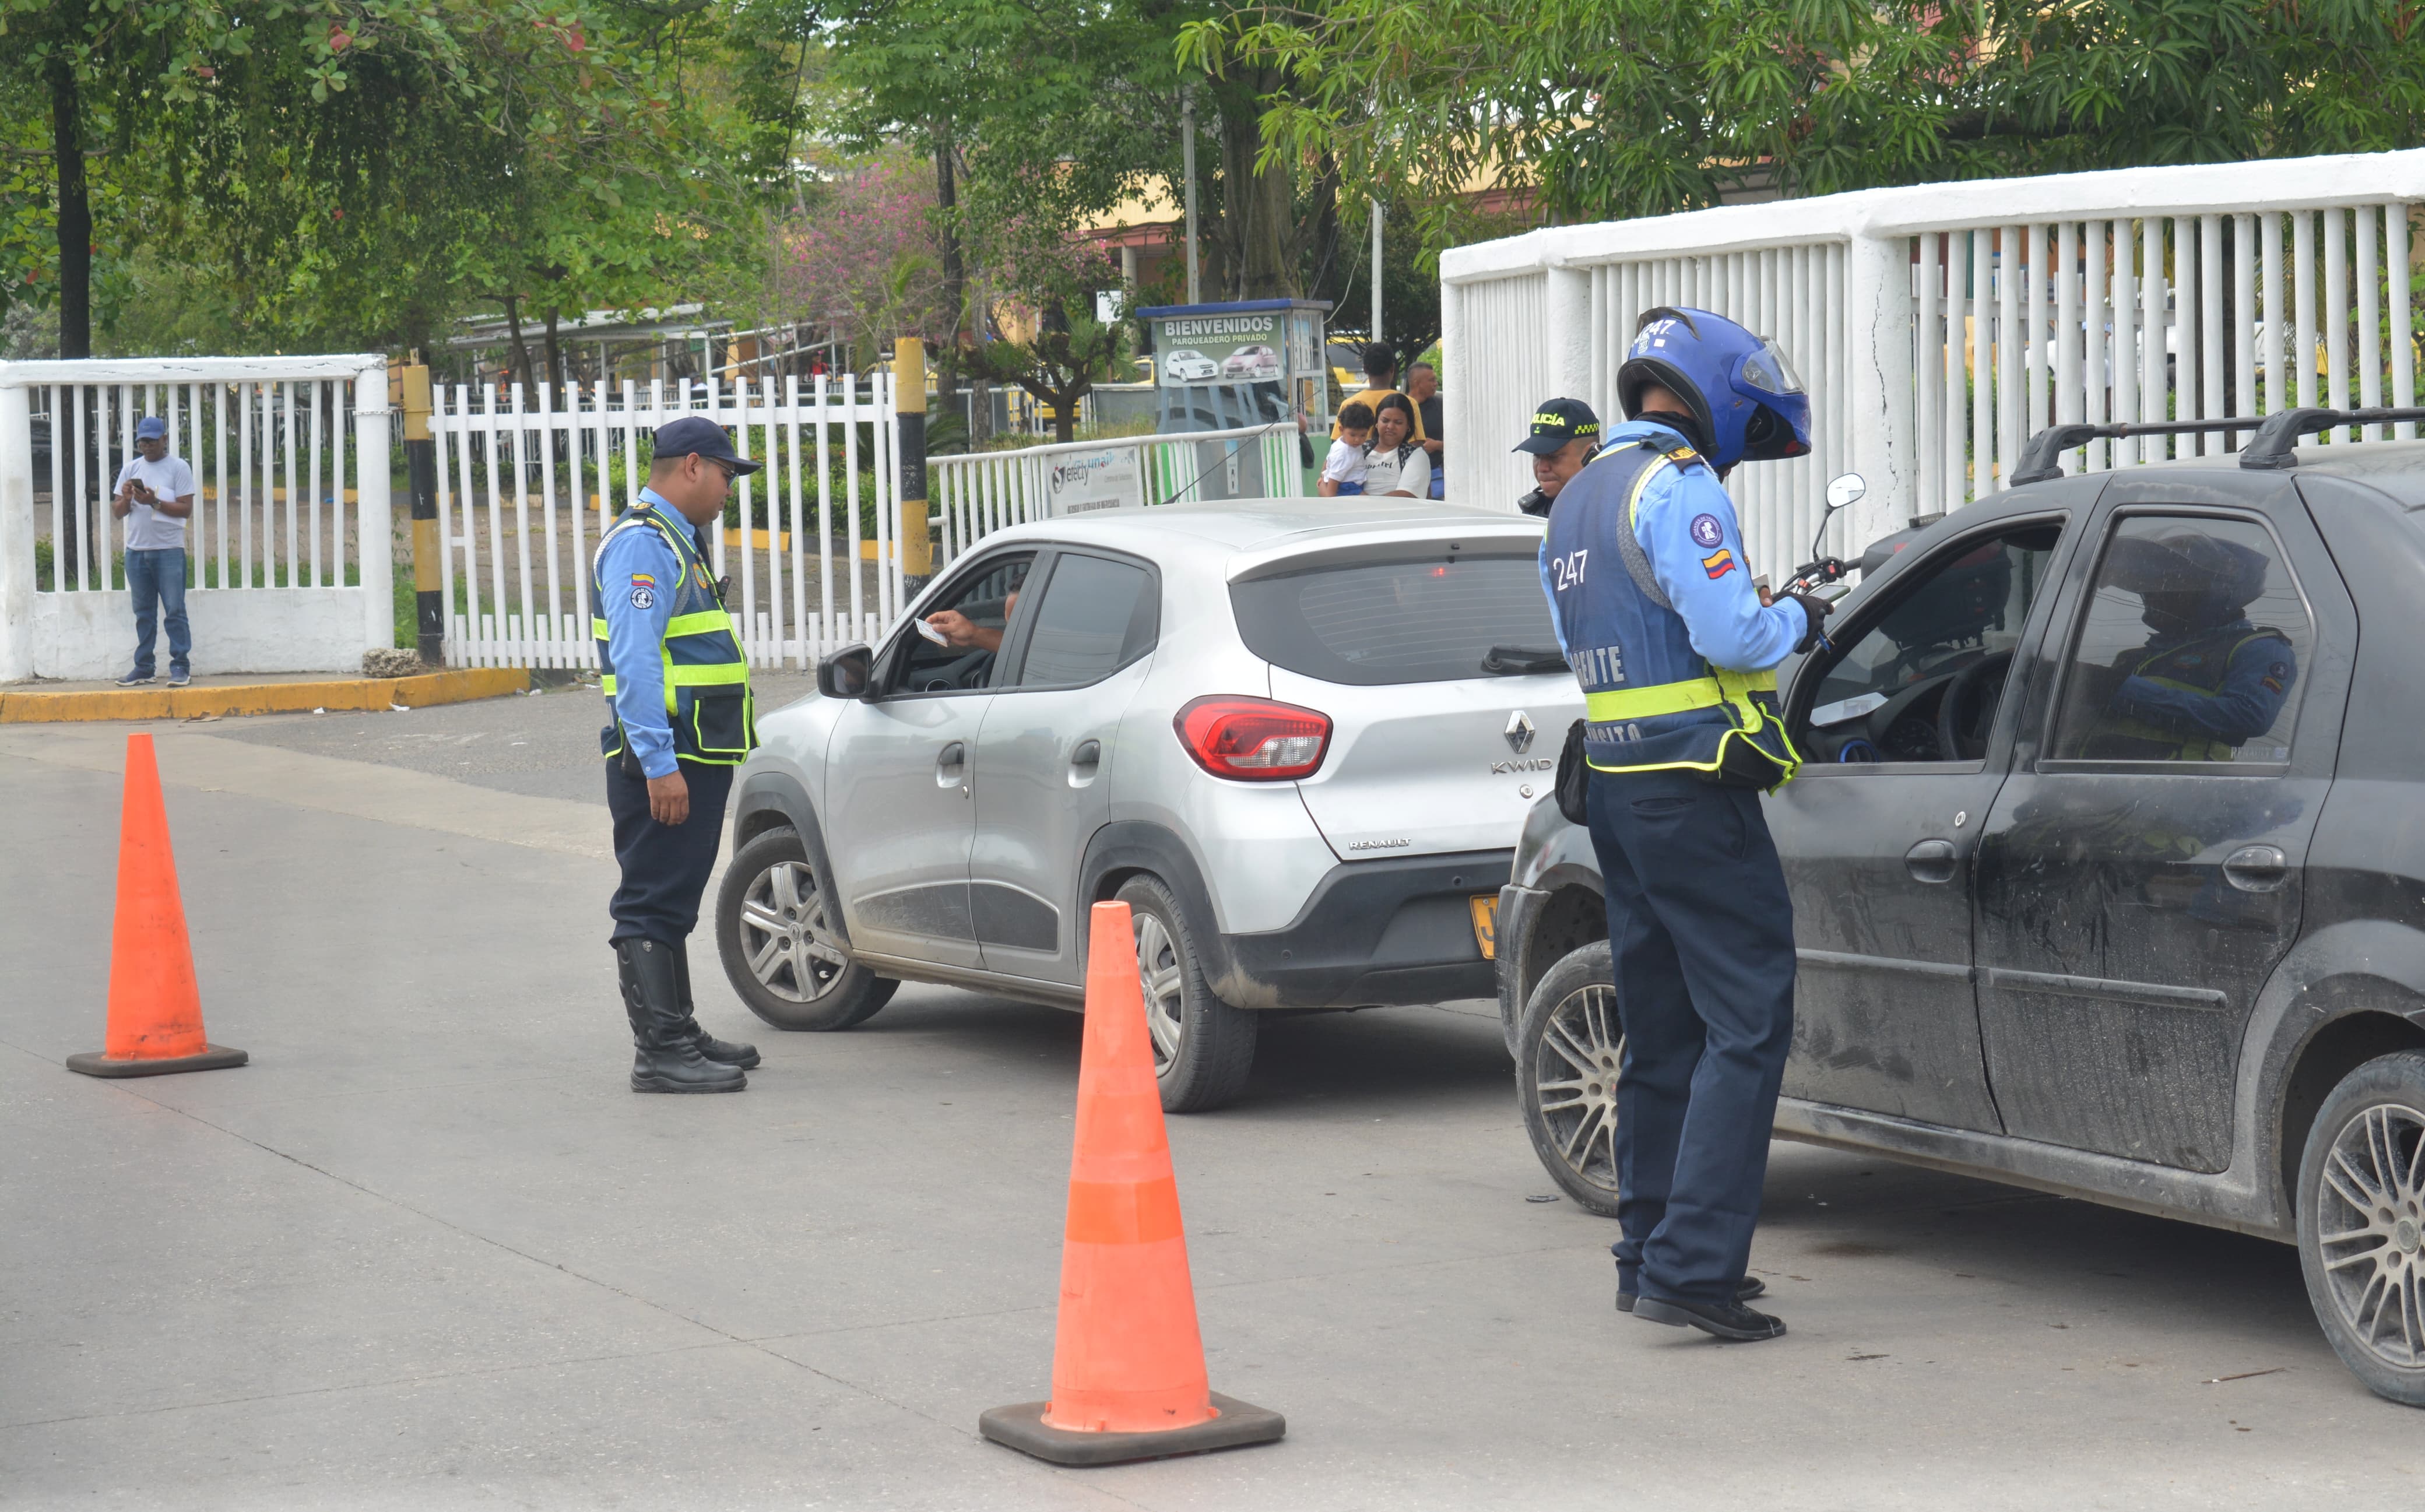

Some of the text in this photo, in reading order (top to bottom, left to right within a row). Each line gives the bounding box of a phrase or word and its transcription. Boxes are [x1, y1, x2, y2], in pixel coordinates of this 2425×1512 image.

[1165, 317, 1273, 336] BIENVENIDOS
[1172, 333, 1267, 346] PARQUEADERO PRIVADO
[1553, 549, 1588, 591] 247
[1491, 758, 1554, 775] KWID
[1348, 838, 1411, 850] RENAULT
